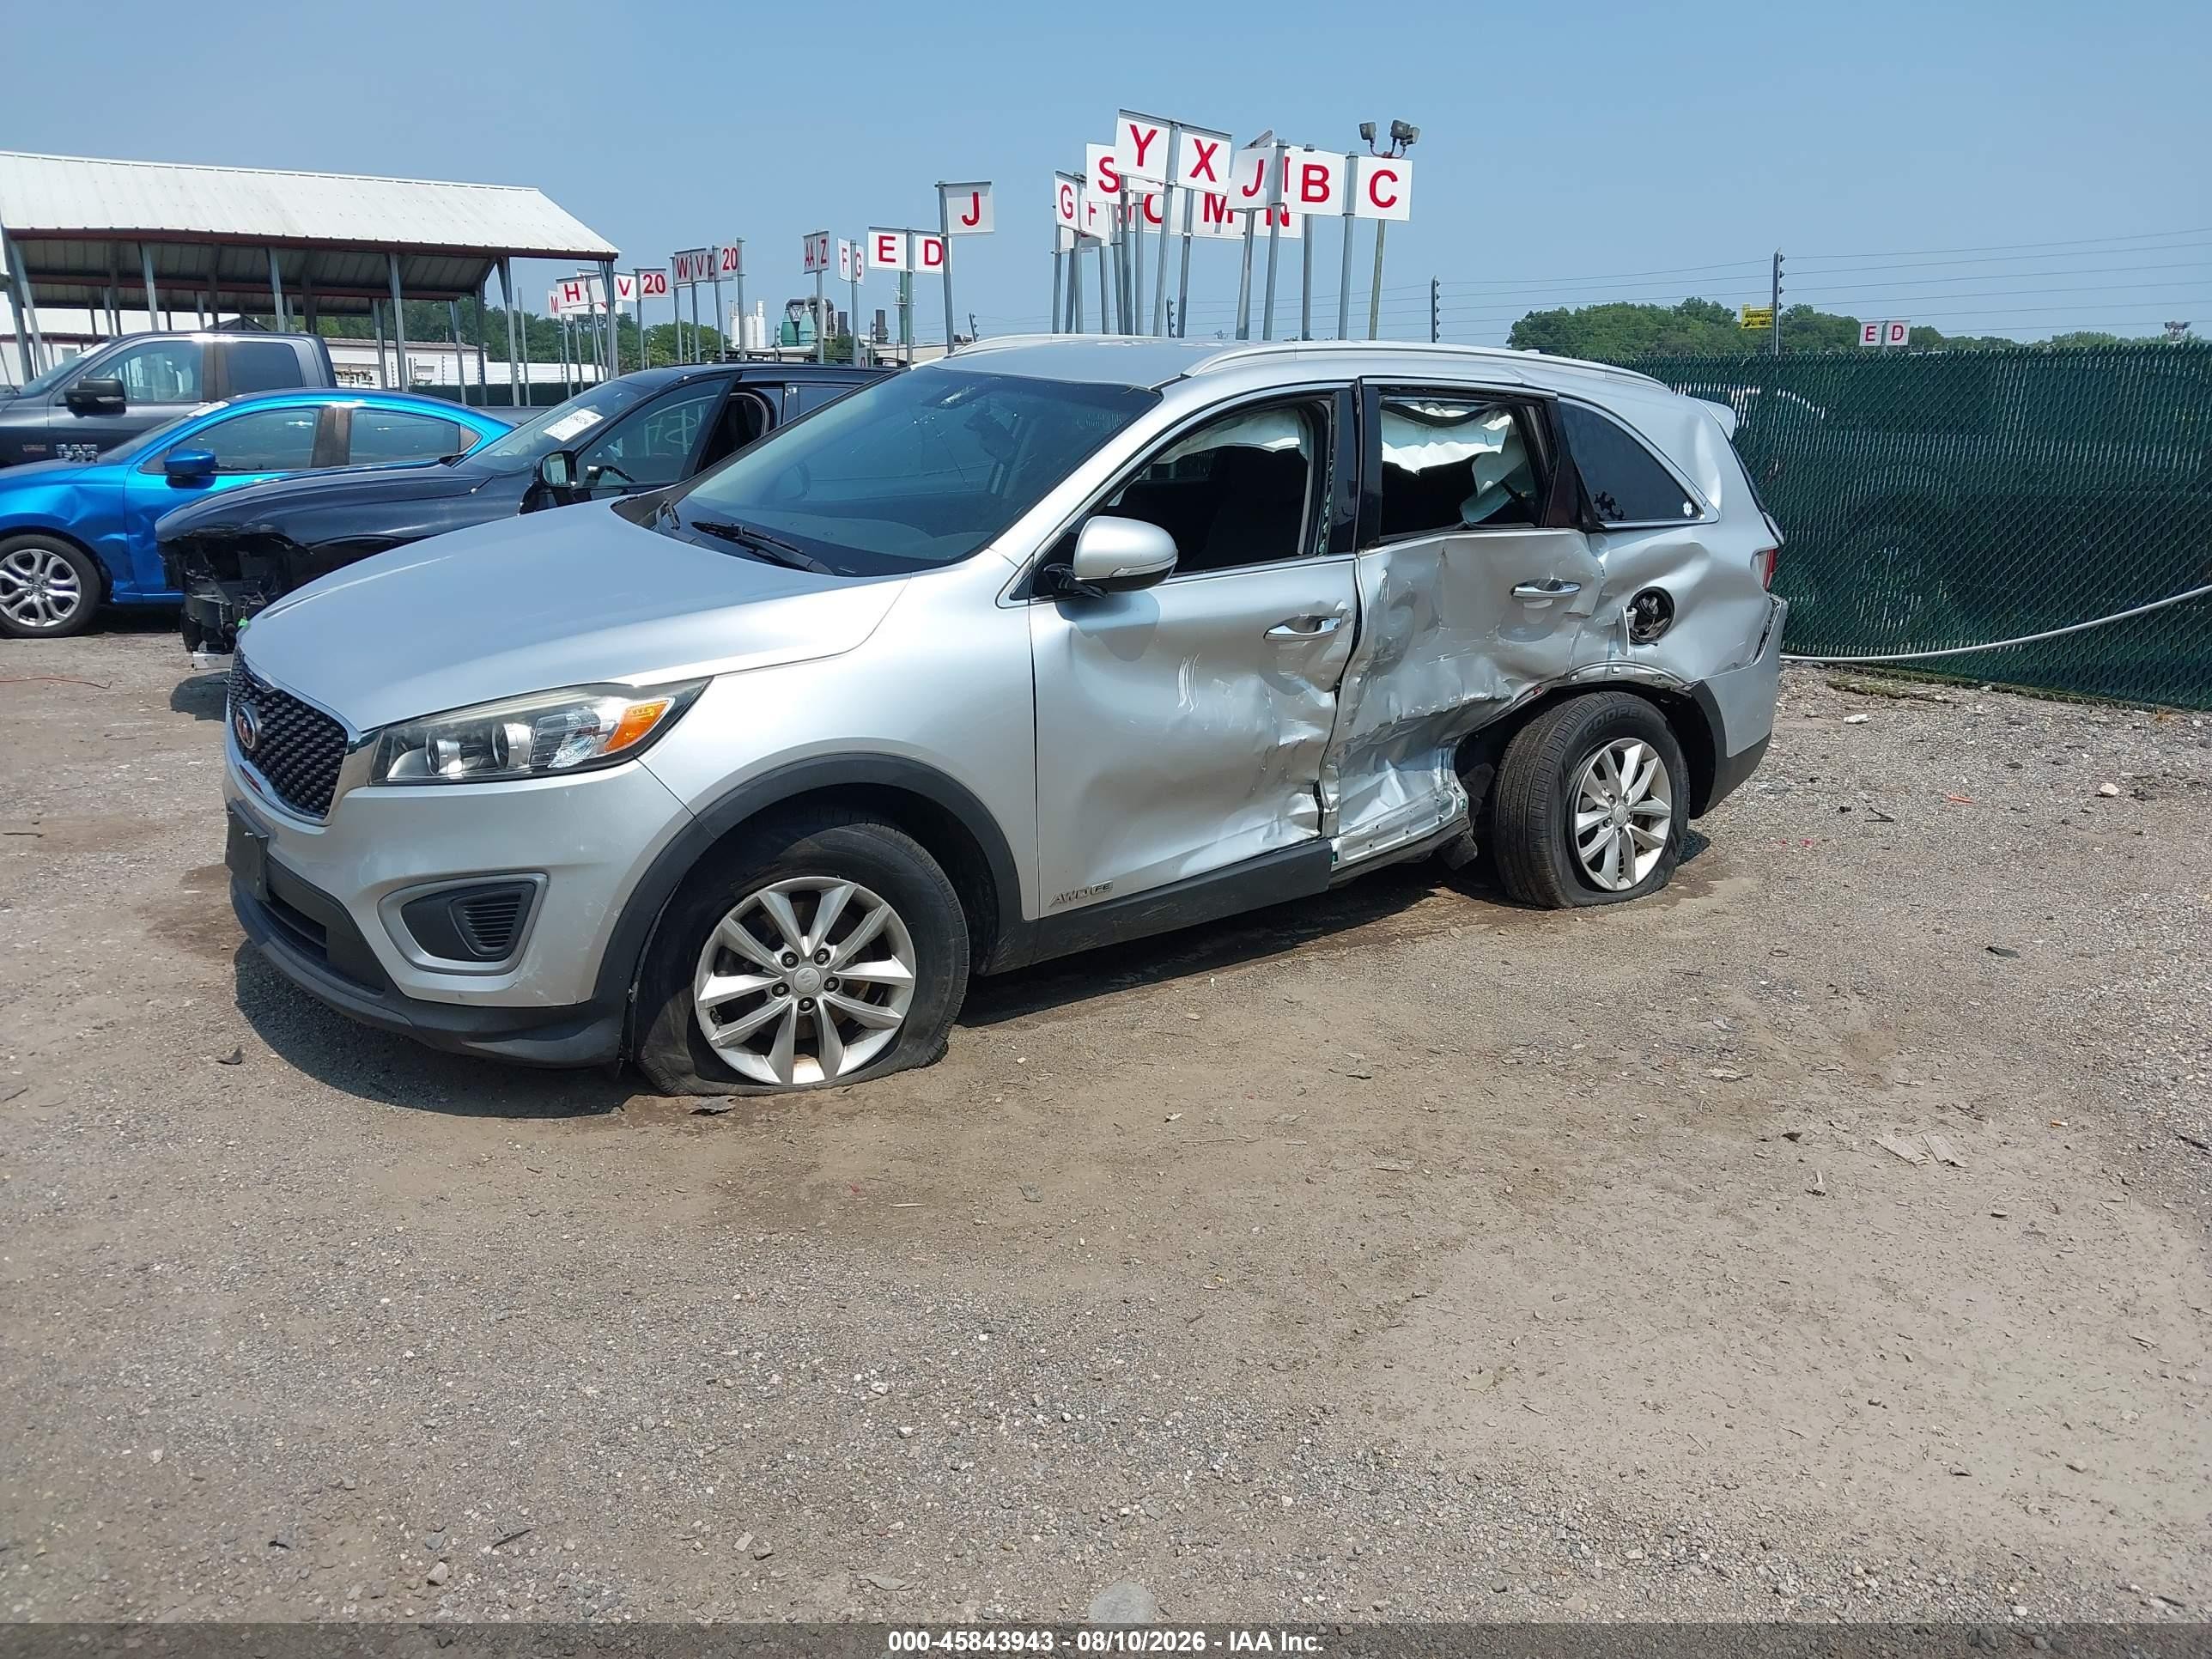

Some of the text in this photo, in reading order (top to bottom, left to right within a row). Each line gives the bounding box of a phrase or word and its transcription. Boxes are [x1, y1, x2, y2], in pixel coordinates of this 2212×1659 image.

[1129, 124, 1219, 182] Y X
[1098, 157, 1120, 193] S
[1242, 159, 1265, 198] J
[1301, 163, 1331, 203] B
[1370, 169, 1398, 209] C
[962, 191, 980, 226] J
[1060, 184, 1073, 219] G
[722, 246, 738, 270] 20
[820, 239, 827, 264] Z
[842, 247, 848, 273] F
[878, 234, 944, 266] E D
[676, 254, 704, 279] W V
[563, 283, 580, 302] H
[617, 274, 666, 296] V 20
[1865, 325, 1904, 342] E D
